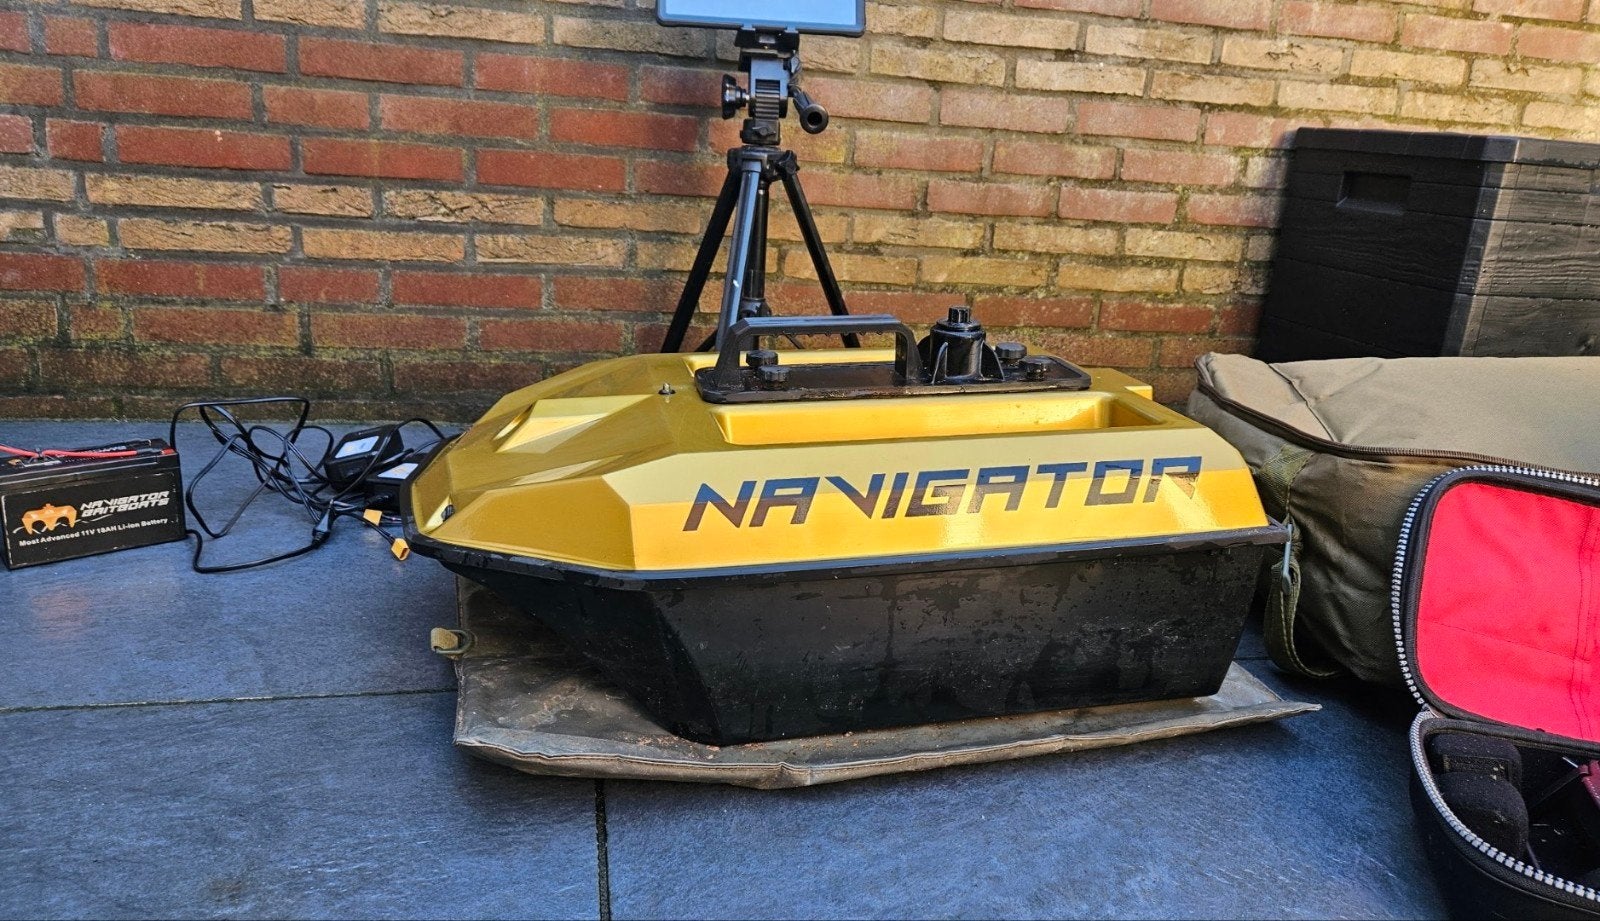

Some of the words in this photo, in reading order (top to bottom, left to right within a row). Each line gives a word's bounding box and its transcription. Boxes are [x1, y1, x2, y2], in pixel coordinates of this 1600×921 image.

[80, 490, 170, 511] NAVIGATOR
[683, 456, 1202, 531] NAVIGATOR
[81, 497, 170, 517] BAITBOATS
[19, 538, 40, 547] Most
[40, 531, 80, 543] Advanced
[118, 521, 140, 530] Li-ion
[141, 518, 168, 527] Battery
